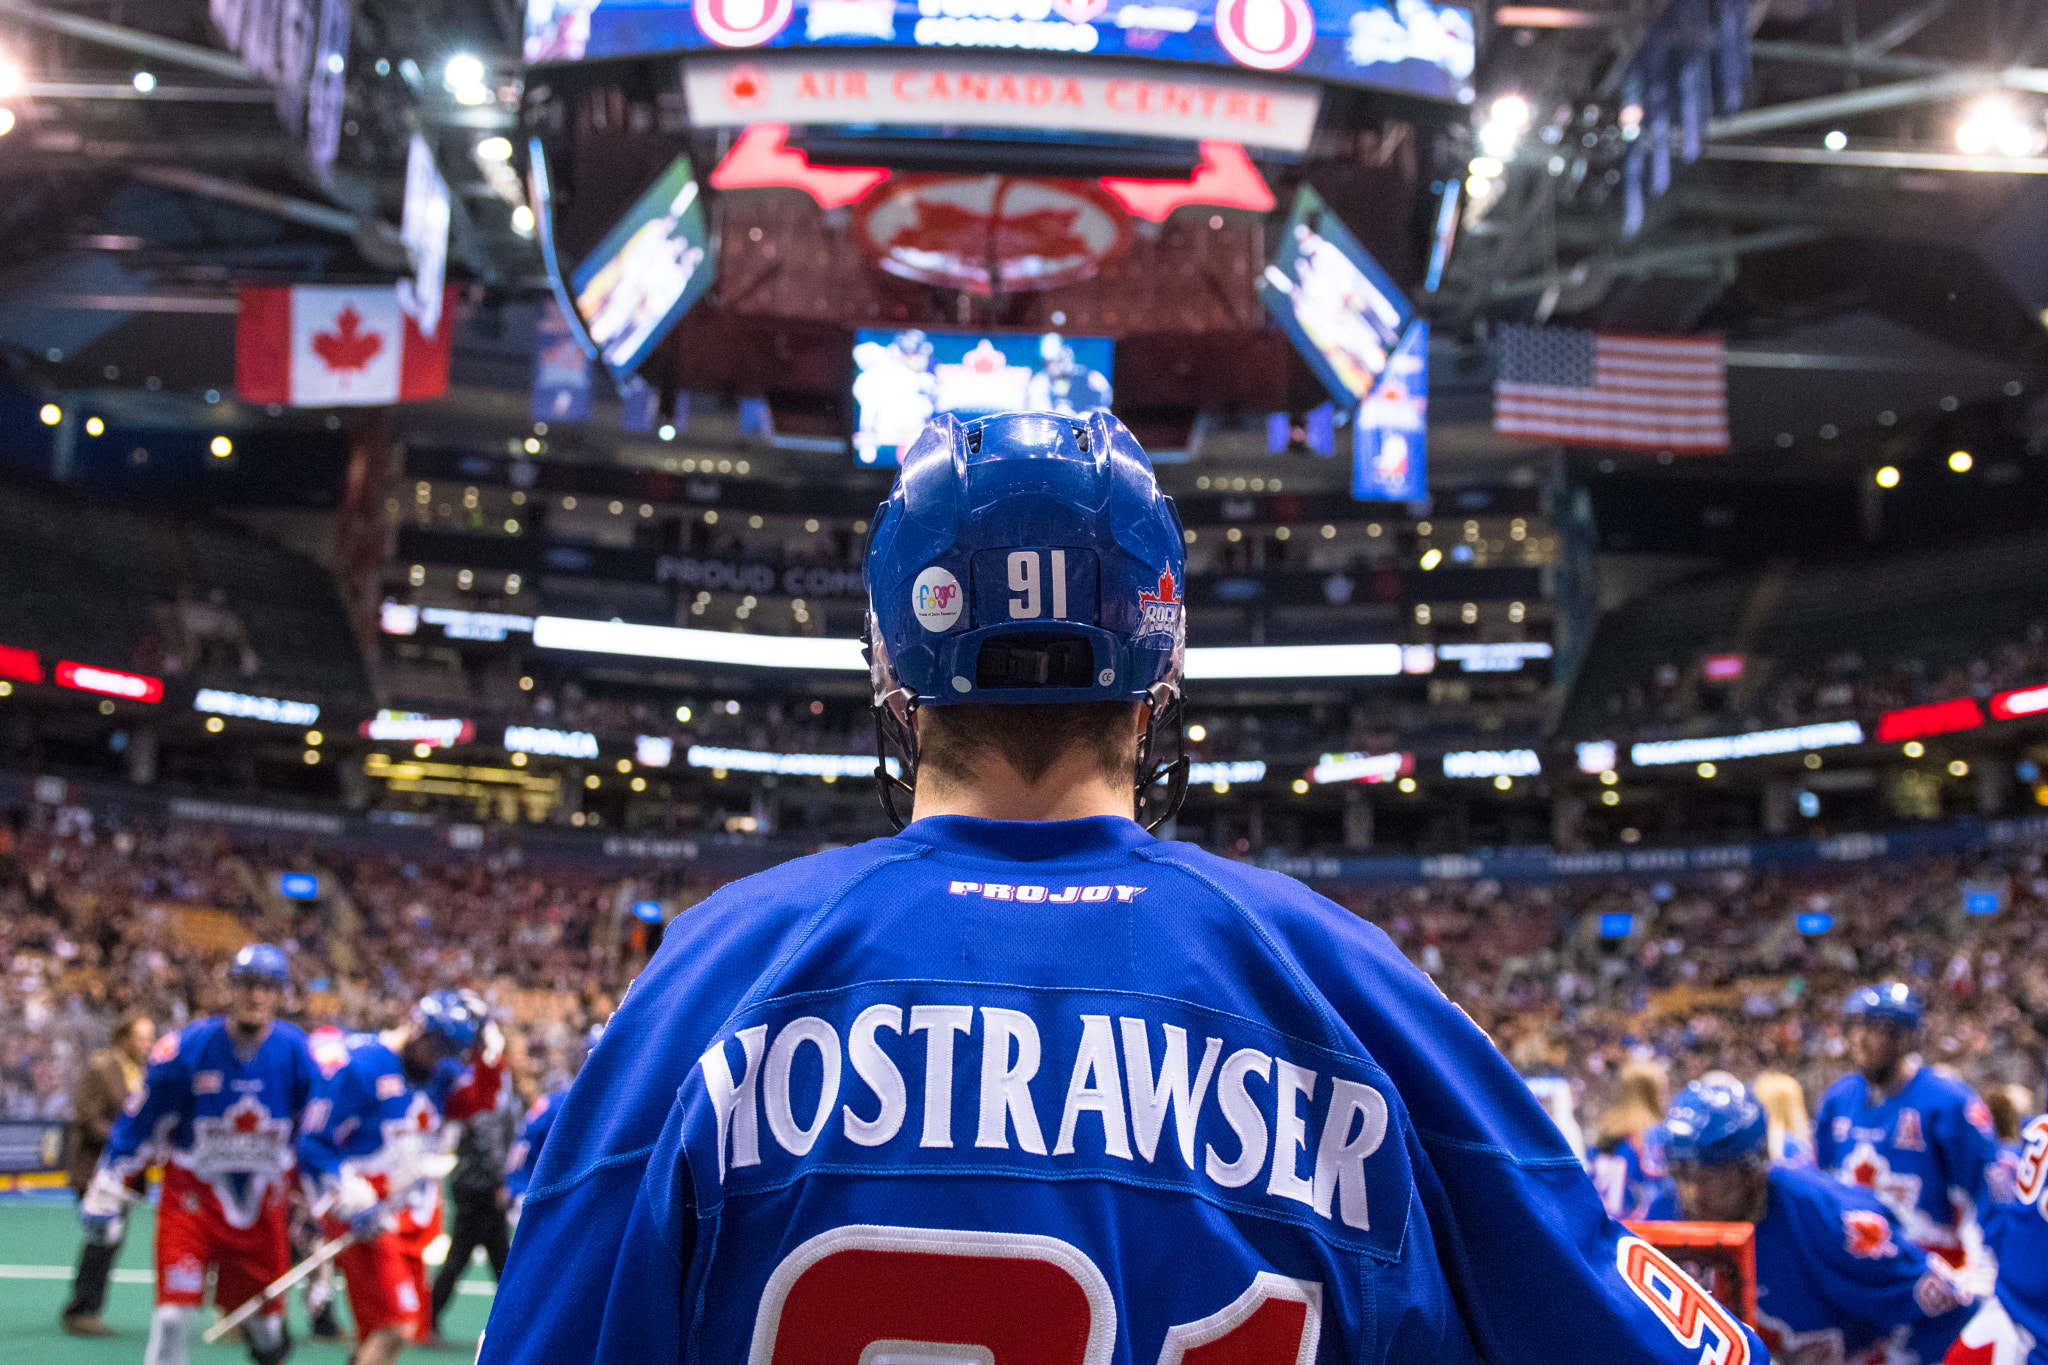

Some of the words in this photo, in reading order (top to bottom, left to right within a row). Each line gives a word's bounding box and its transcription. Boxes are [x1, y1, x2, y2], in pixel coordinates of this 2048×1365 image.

[797, 71, 868, 100] AIR
[892, 71, 1085, 107] CANADA
[1104, 79, 1273, 124] CENTRE
[1007, 551, 1067, 619] 91
[949, 880, 1148, 903] PROJOY
[700, 1004, 1388, 1231] HOSTRAWSER
